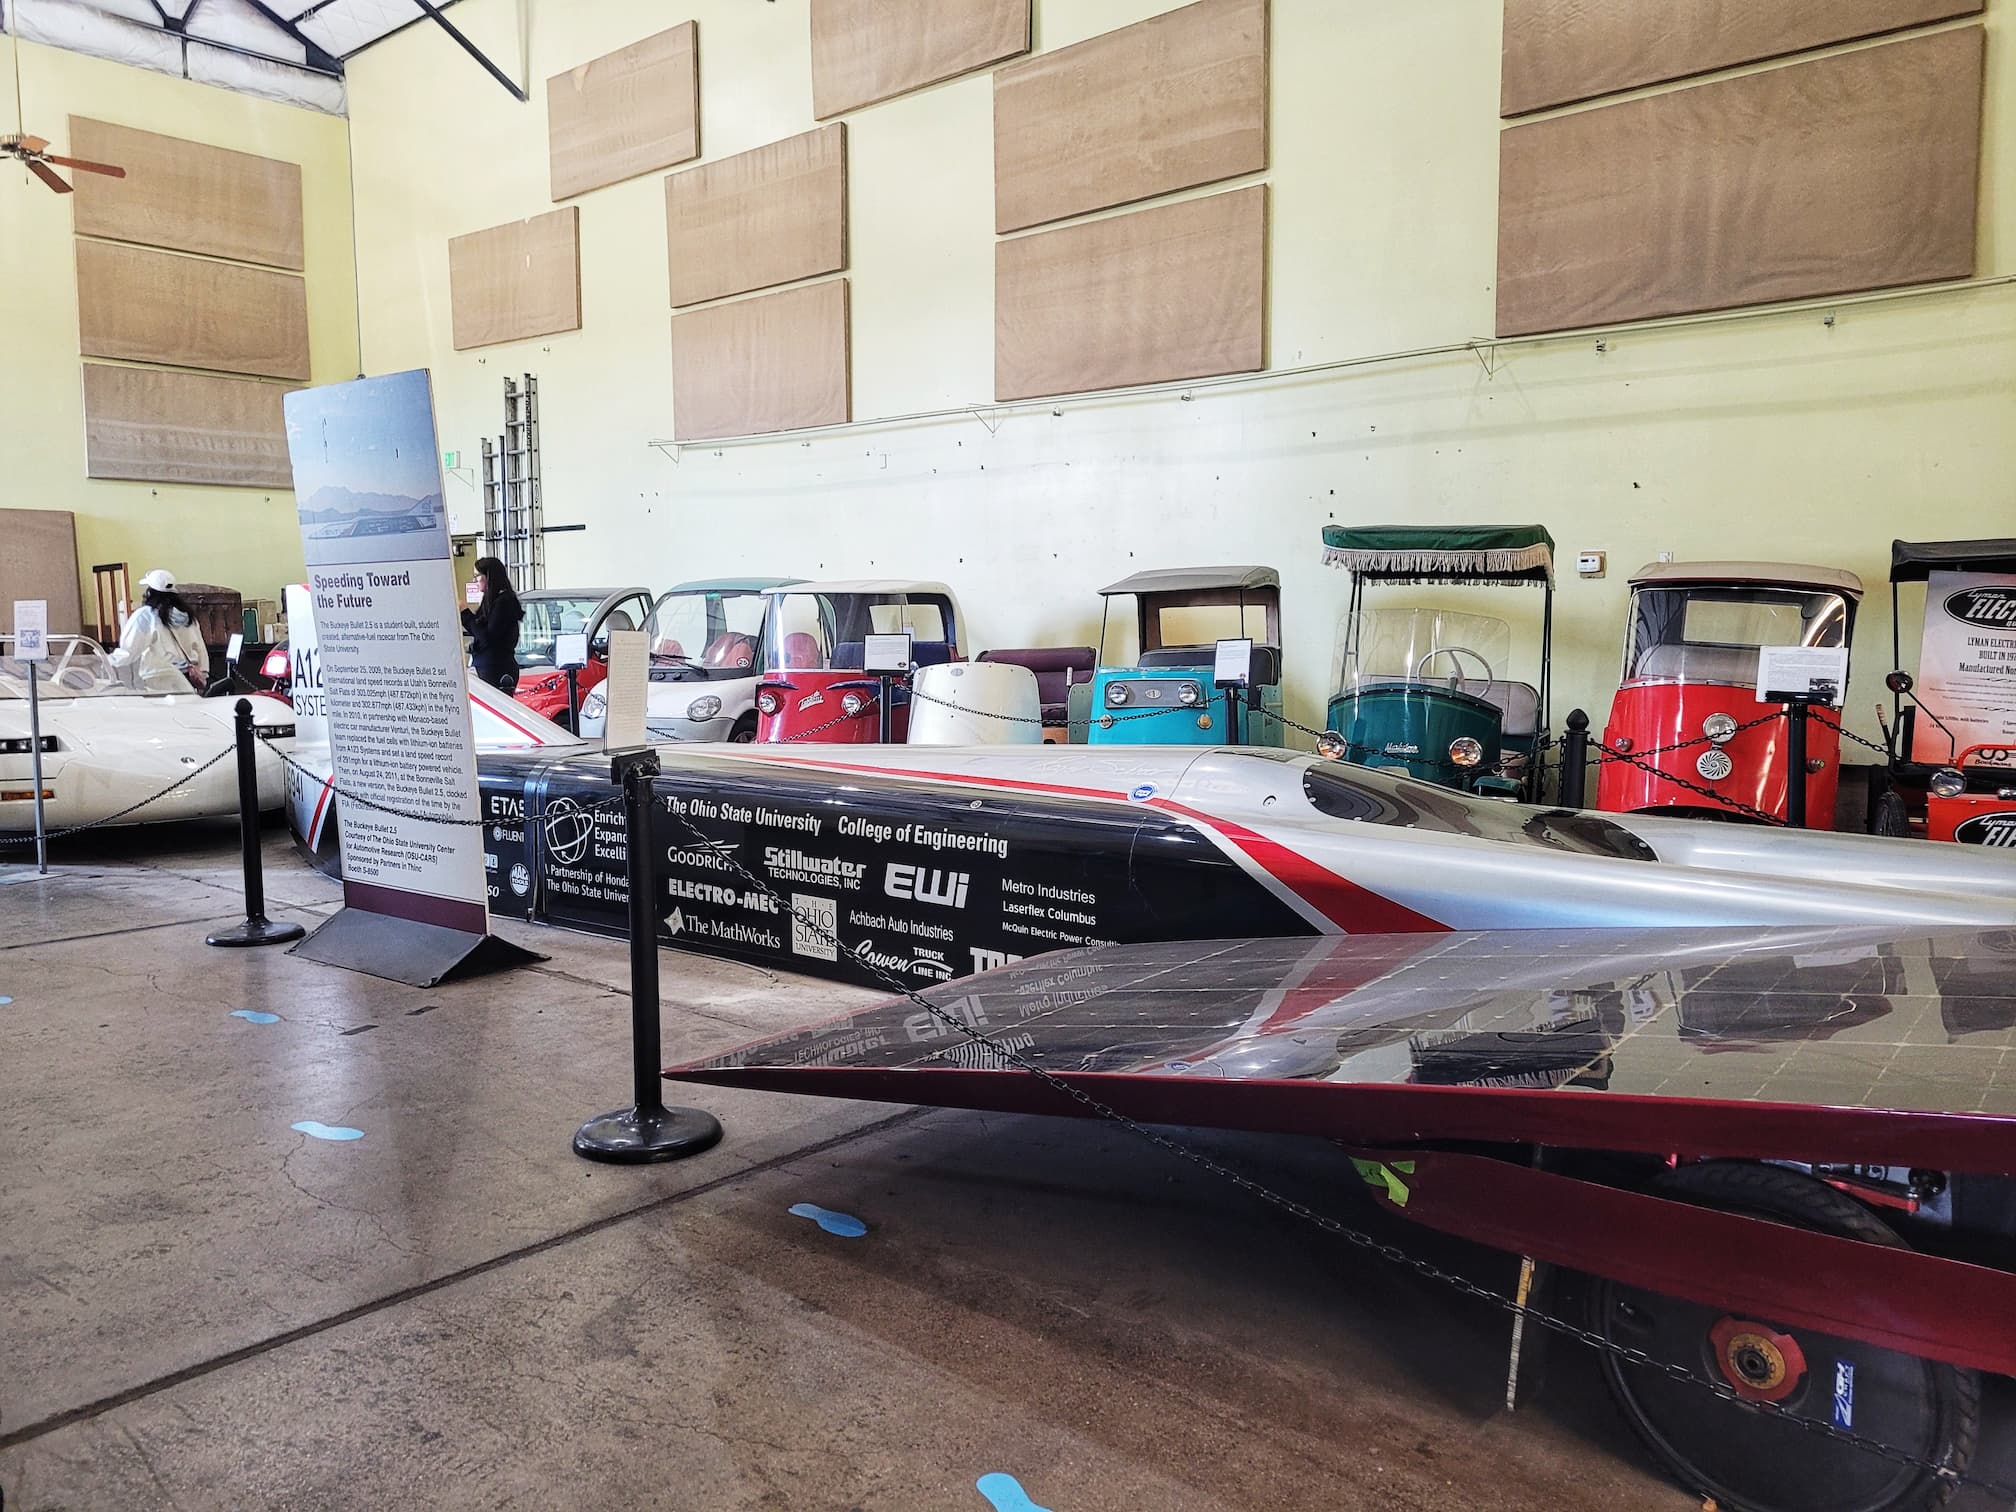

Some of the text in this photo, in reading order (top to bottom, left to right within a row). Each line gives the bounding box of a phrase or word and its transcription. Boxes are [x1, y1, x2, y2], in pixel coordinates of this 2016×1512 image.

[314, 570, 411, 592] Speeding Toward
[317, 594, 373, 609] the Future
[350, 620, 364, 629] Bullet
[365, 621, 373, 629] 2.5
[418, 620, 439, 629] student
[397, 632, 435, 641] from The Ohio
[393, 666, 415, 677] Buckeye
[416, 666, 431, 676] Bullet
[1959, 661, 2004, 675] Manufactured
[367, 677, 383, 688] speed
[384, 677, 403, 687] records
[428, 679, 457, 689] Bonneville
[295, 693, 327, 717] SYSTE
[429, 691, 454, 703] the flying
[434, 703, 460, 715] the flying
[408, 714, 448, 725] Monaco-based
[411, 726, 461, 739] the Buckeye Bullet
[399, 737, 409, 746] with
[382, 747, 391, 757] and
[405, 749, 417, 759] land
[418, 750, 434, 761] speed
[435, 752, 453, 762] record
[399, 761, 418, 772] battery
[418, 763, 441, 773] powered
[406, 773, 414, 782] the
[415, 774, 443, 786] Bonneville
[387, 782, 395, 791] the
[396, 783, 418, 795] Buckeye
[418, 785, 434, 796] Bullet
[422, 796, 430, 806] the
[451, 800, 461, 811] the
[343, 819, 398, 835] The Buckeye Bullet 2.5
[666, 795, 1009, 860] The Ohio State University College of Engineering
[344, 830, 456, 855] Courtesy The Ohio State University Center
[353, 842, 438, 865] Automotive Research (OSU-CARS)
[346, 852, 423, 873] Sponsored by Partners Thinc
[347, 863, 362, 874] Booth
[763, 846, 867, 879] Stillwater
[550, 863, 593, 884] Partnership
[594, 871, 604, 882] of
[605, 872, 630, 888] Honda
[768, 866, 861, 891] TECHNOLOGIES, INC
[546, 878, 630, 903] The Ohio State Univer
[668, 877, 780, 915] ELECTRO-MEC
[1001, 878, 1096, 905] Metro Industries
[795, 905, 834, 929] OHIO
[1002, 900, 1097, 926] Laserflex Columbus
[685, 914, 781, 950] The MathWorks
[849, 908, 954, 942] Achbach Auto Industries
[1002, 921, 1029, 936] McQuin
[1030, 926, 1058, 940] Electric
[1059, 931, 1083, 945] Power
[795, 942, 835, 957] UNIVERSITY
[912, 946, 945, 962] TRUCK
[913, 964, 952, 982] LINE INC
